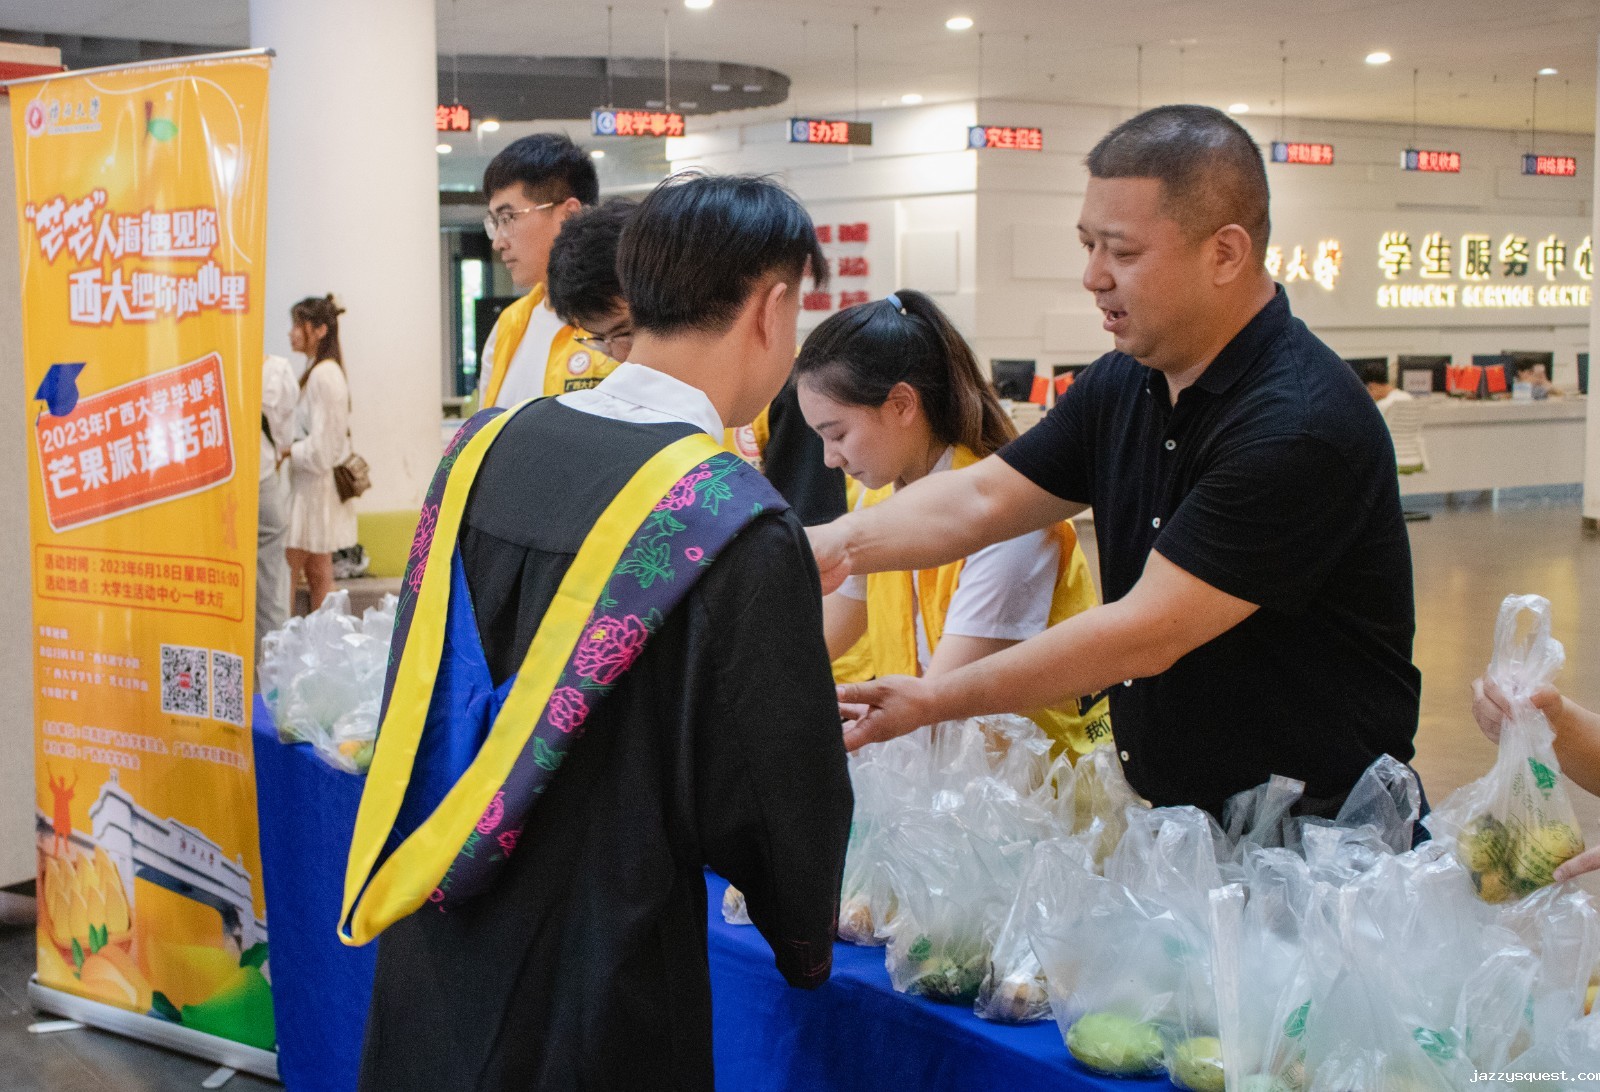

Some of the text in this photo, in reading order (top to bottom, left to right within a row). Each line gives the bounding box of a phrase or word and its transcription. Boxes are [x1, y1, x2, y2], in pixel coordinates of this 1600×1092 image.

[437, 105, 470, 130] 咨询
[616, 112, 684, 135] 教学事务
[70, 262, 247, 323] 西大把你放心里
[1377, 284, 1457, 308] STUDENT
[1462, 284, 1534, 308] SERVICE
[43, 373, 216, 451] 2023年广西大学毕业季
[48, 407, 223, 499] 芒果派送活动
